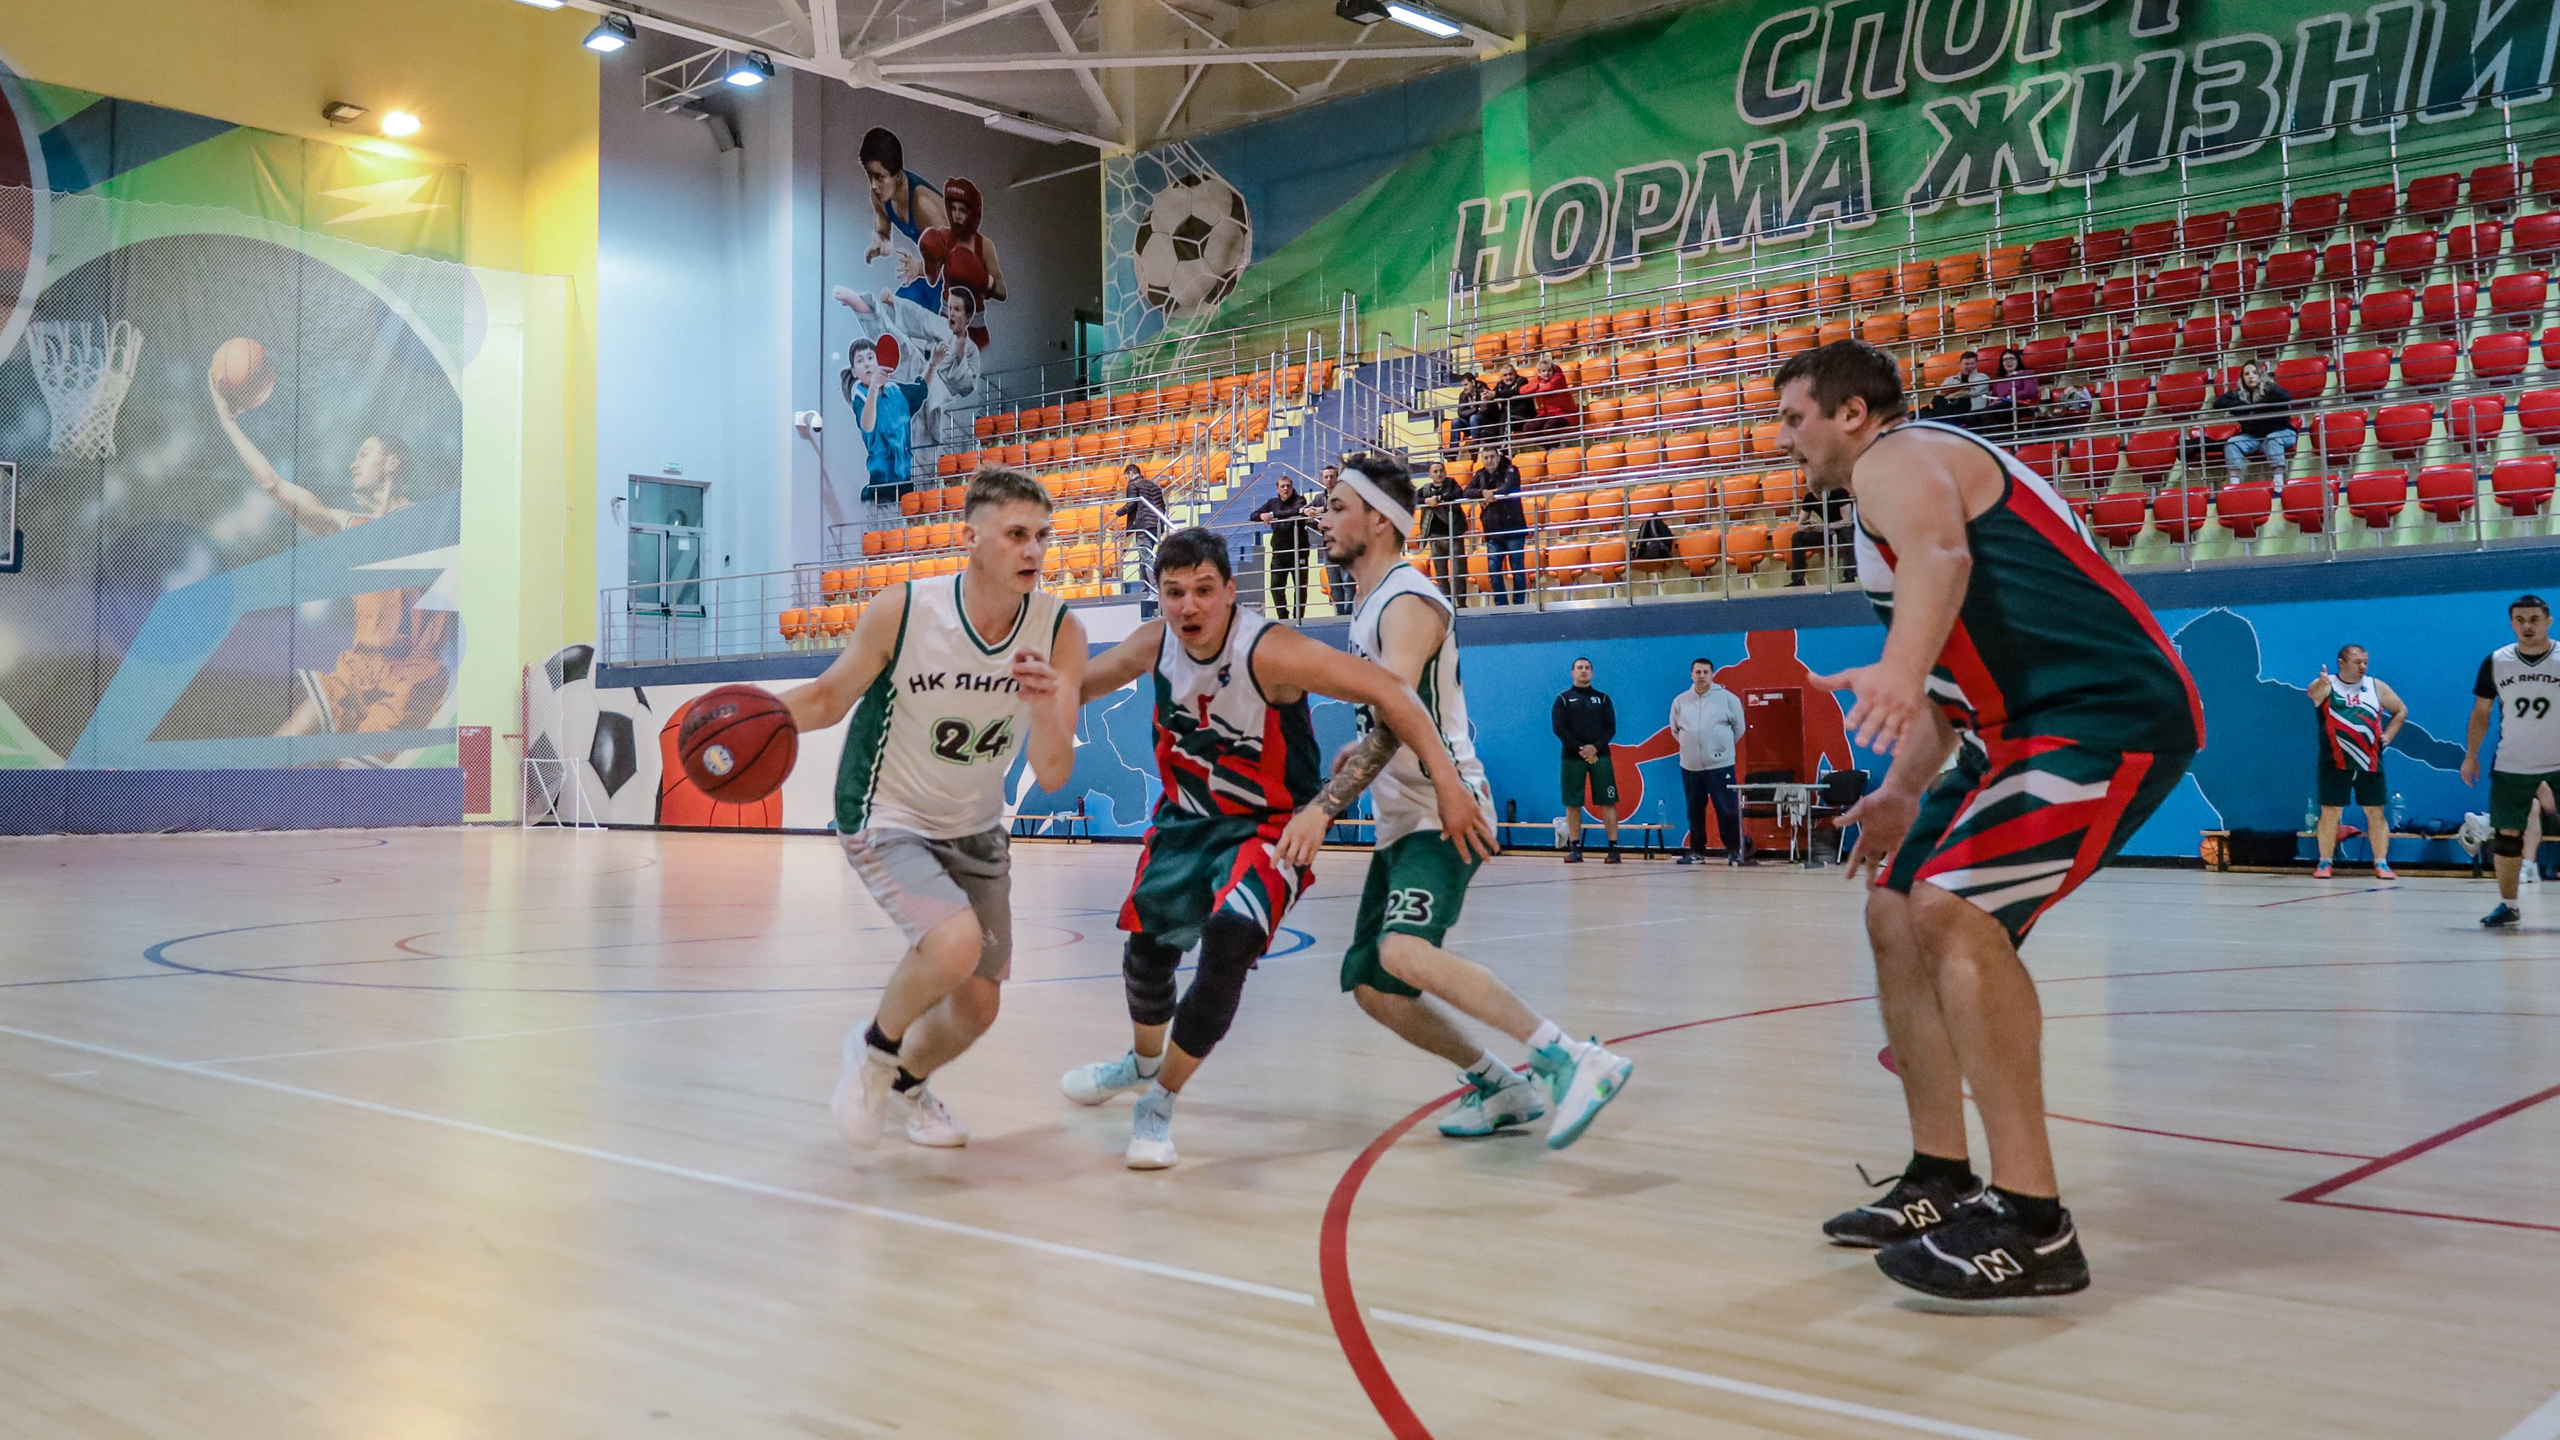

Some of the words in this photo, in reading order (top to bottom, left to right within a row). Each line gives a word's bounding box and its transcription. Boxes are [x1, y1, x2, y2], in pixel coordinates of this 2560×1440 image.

[1453, 119, 1877, 298] НОРМА
[1903, 0, 2560, 215] ЖИЗНИ
[908, 672, 946, 694] НК
[955, 673, 1020, 693] ЯНГП
[2519, 673, 2560, 687] ЯНГПУ
[2346, 693, 2361, 706] 14
[2515, 697, 2550, 719] 99
[931, 715, 1013, 765] 24
[1383, 888, 1434, 926] 23
[1903, 1199, 1941, 1228] N
[1973, 1248, 2023, 1282] N
